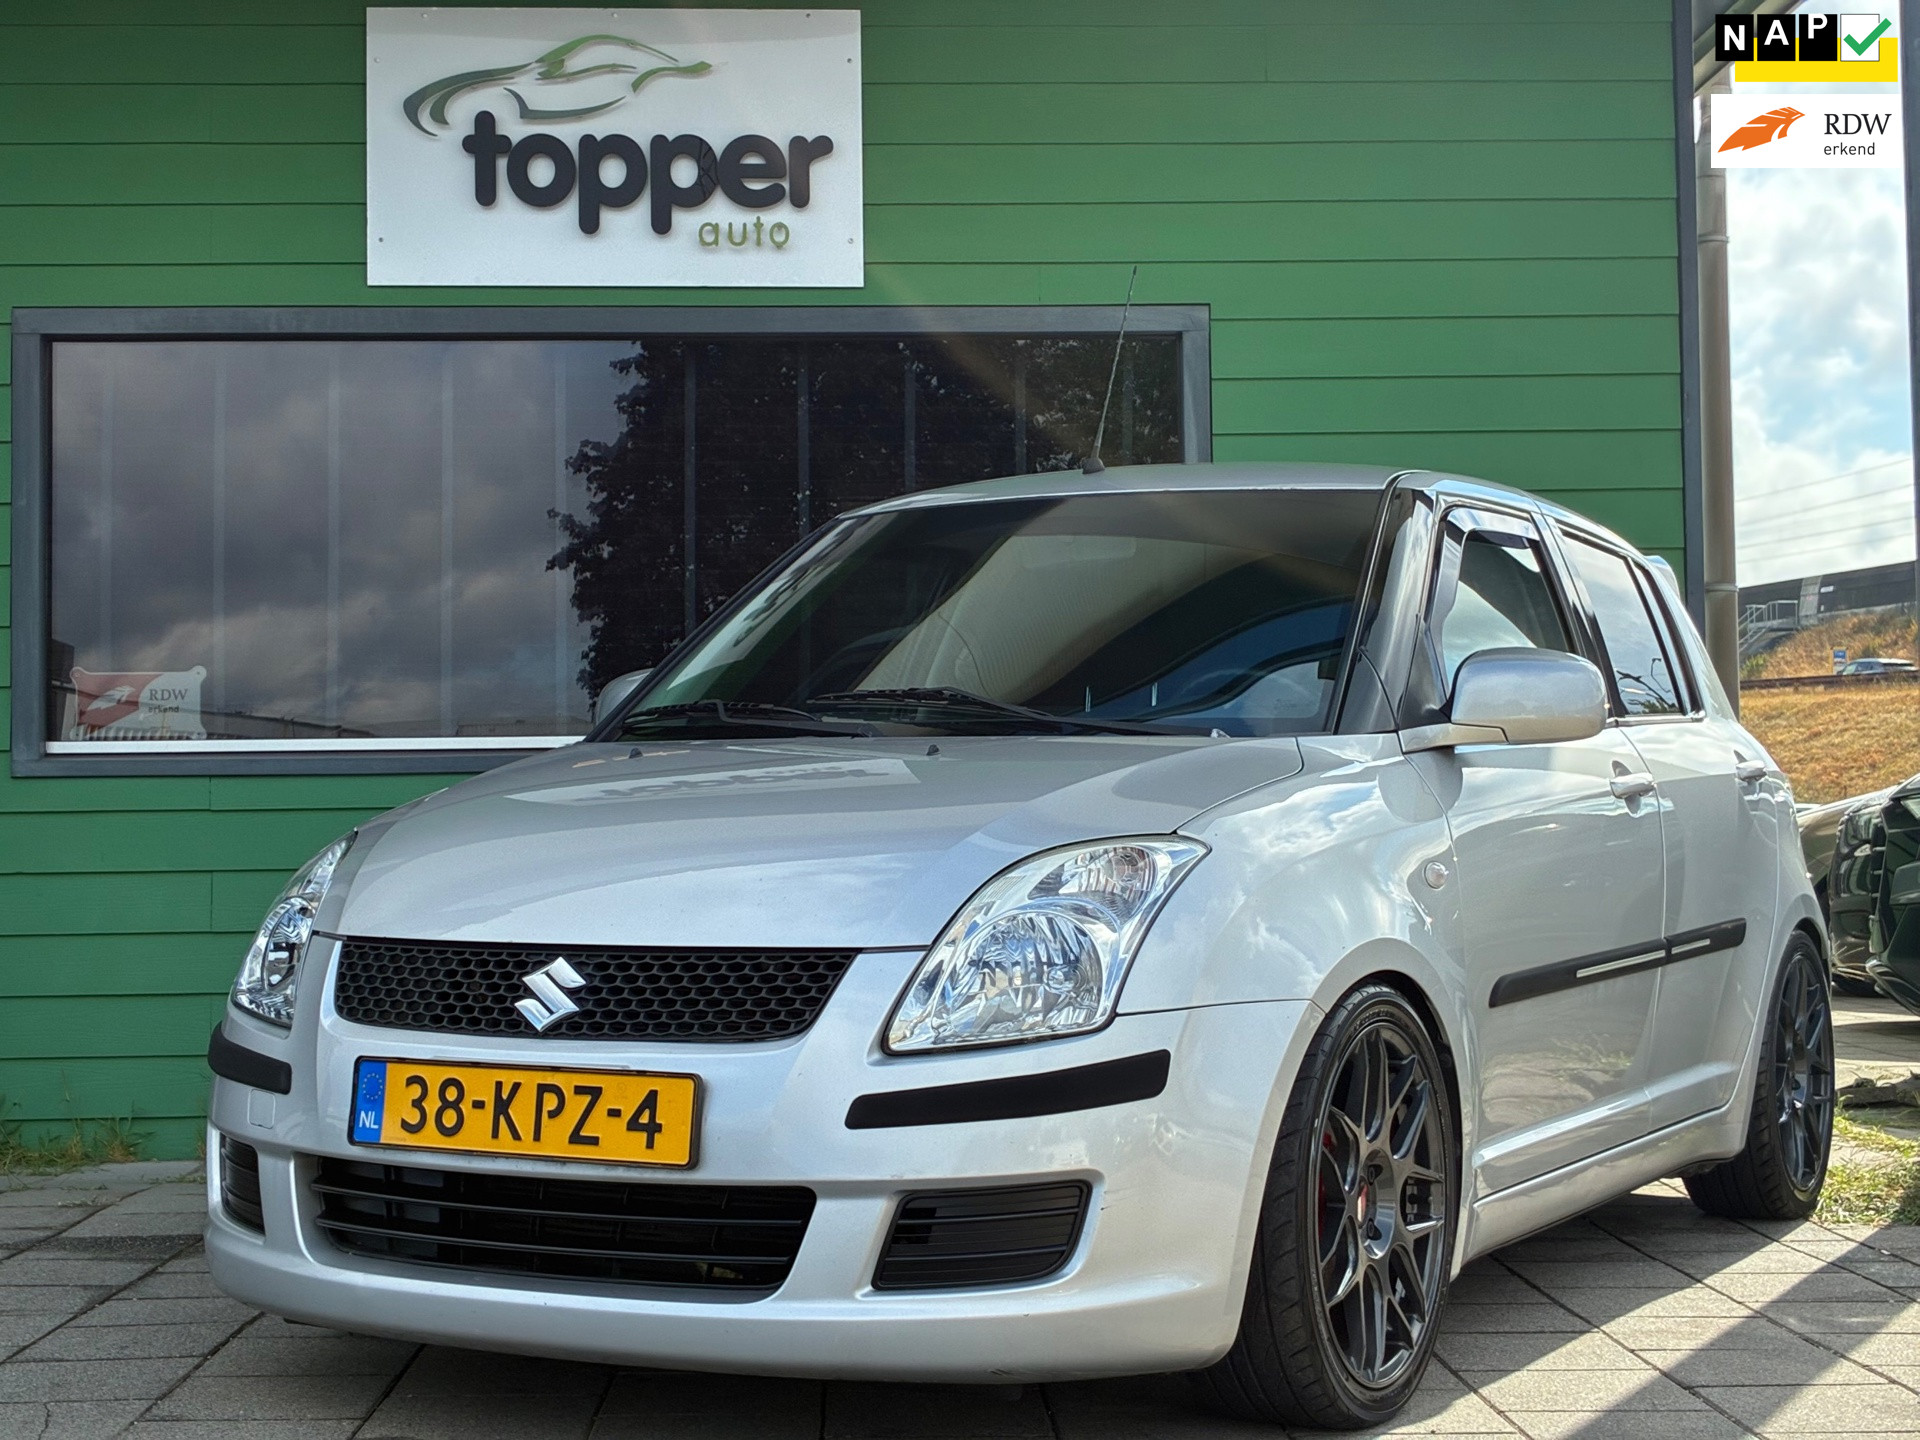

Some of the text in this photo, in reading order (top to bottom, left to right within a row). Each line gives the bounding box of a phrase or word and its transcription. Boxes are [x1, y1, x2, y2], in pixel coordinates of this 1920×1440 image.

[461, 110, 835, 236] topper
[698, 215, 791, 249] auto
[149, 688, 189, 701] RDW
[148, 704, 180, 714] erkend
[358, 1110, 380, 1129] NL
[400, 1074, 663, 1150] 38-KPZ-4
